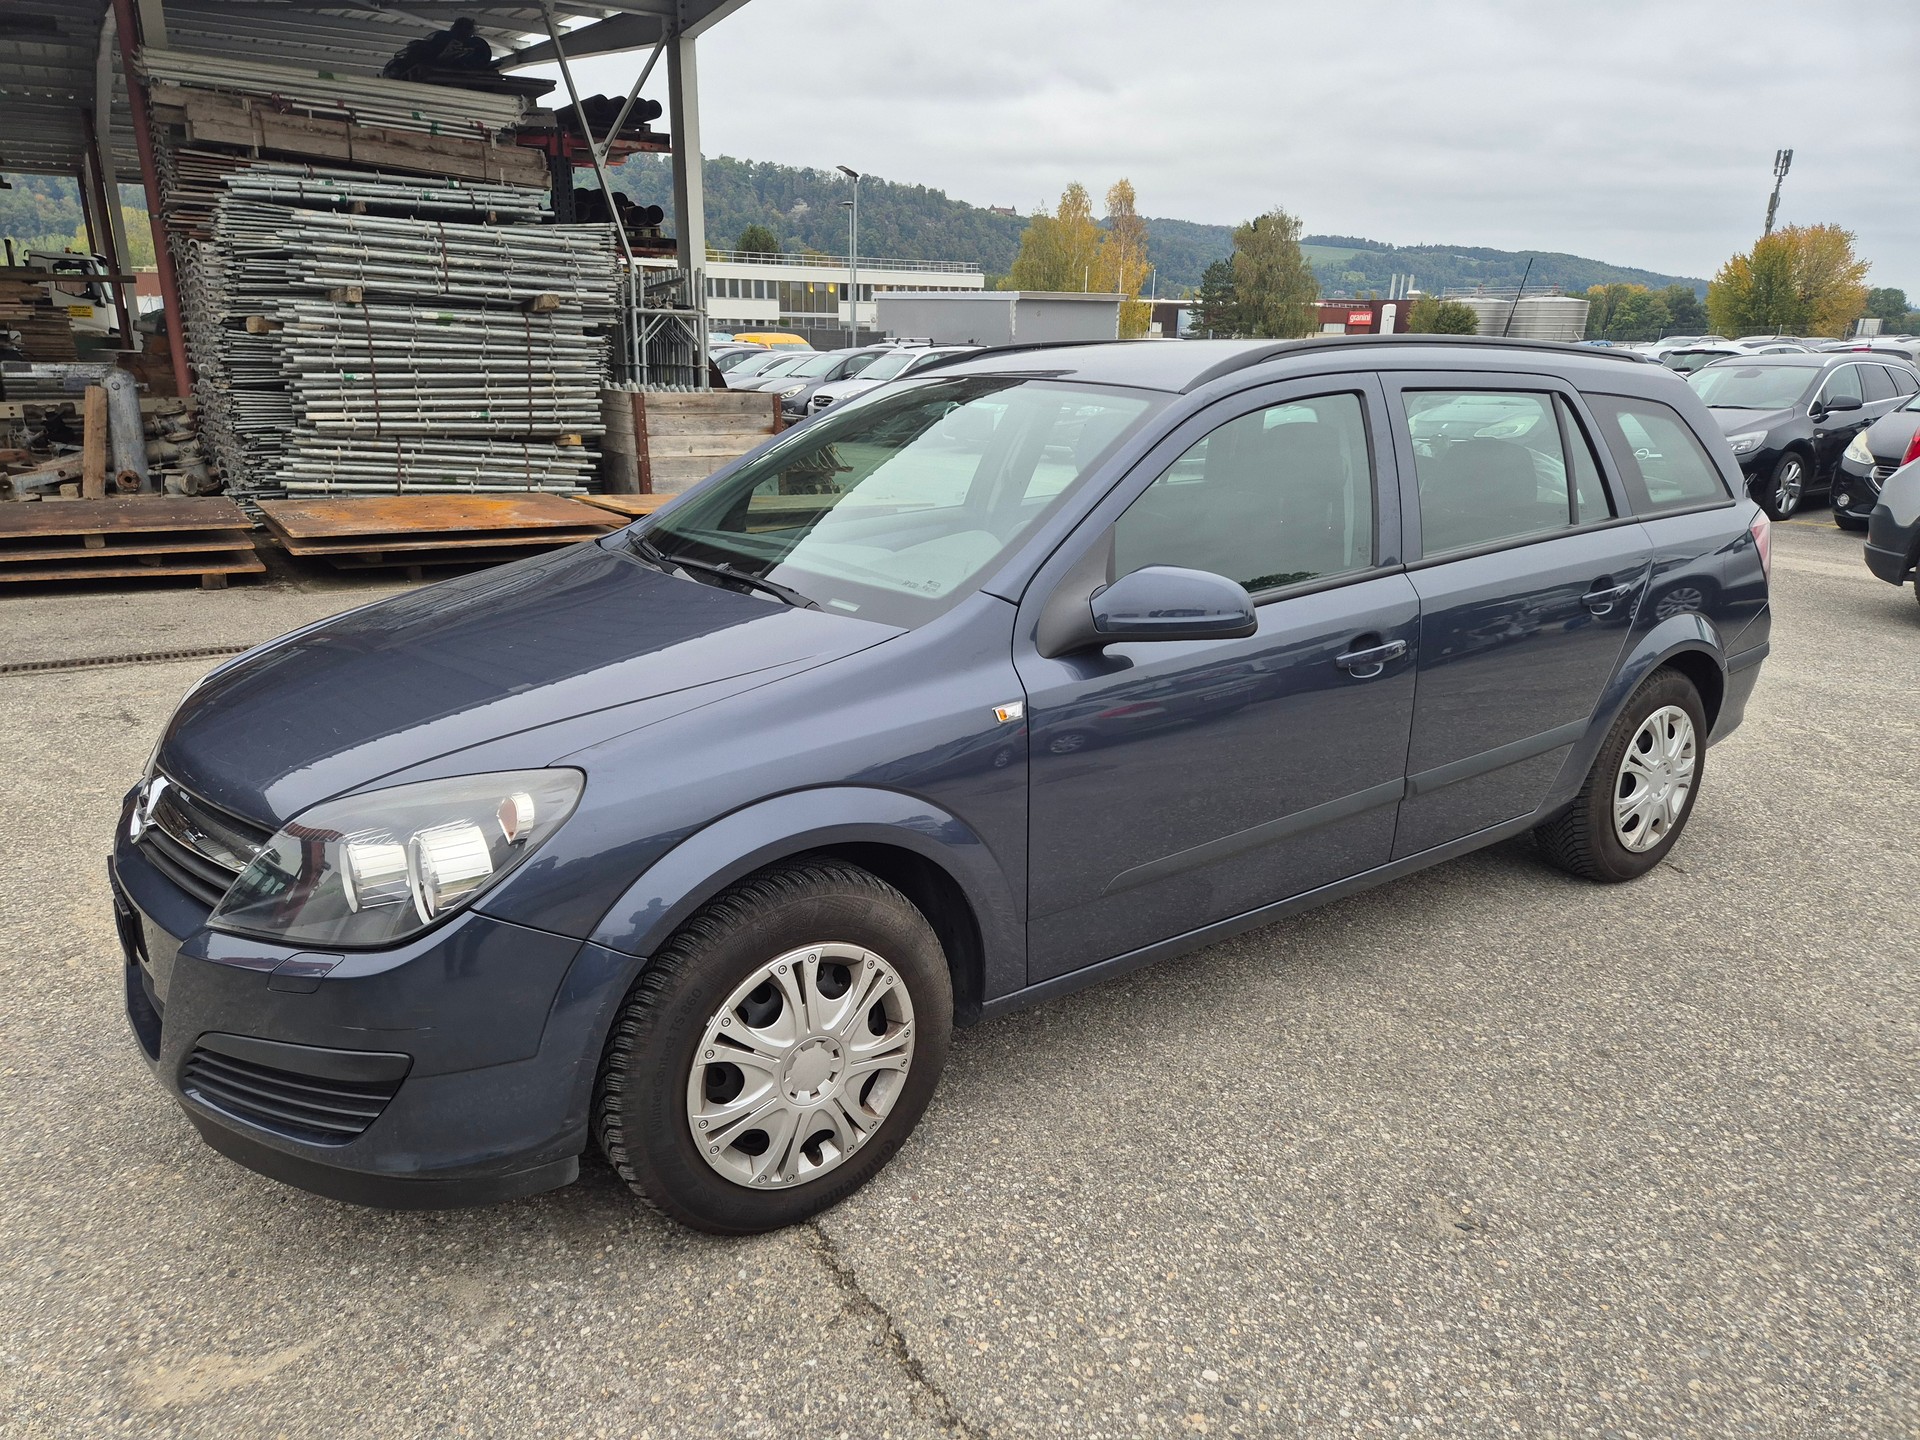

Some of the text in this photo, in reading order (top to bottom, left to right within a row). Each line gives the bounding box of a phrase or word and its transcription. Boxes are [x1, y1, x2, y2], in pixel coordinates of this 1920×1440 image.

[1350, 313, 1370, 322] granini
[669, 1015, 685, 1032] TS
[680, 988, 703, 1014] 860
